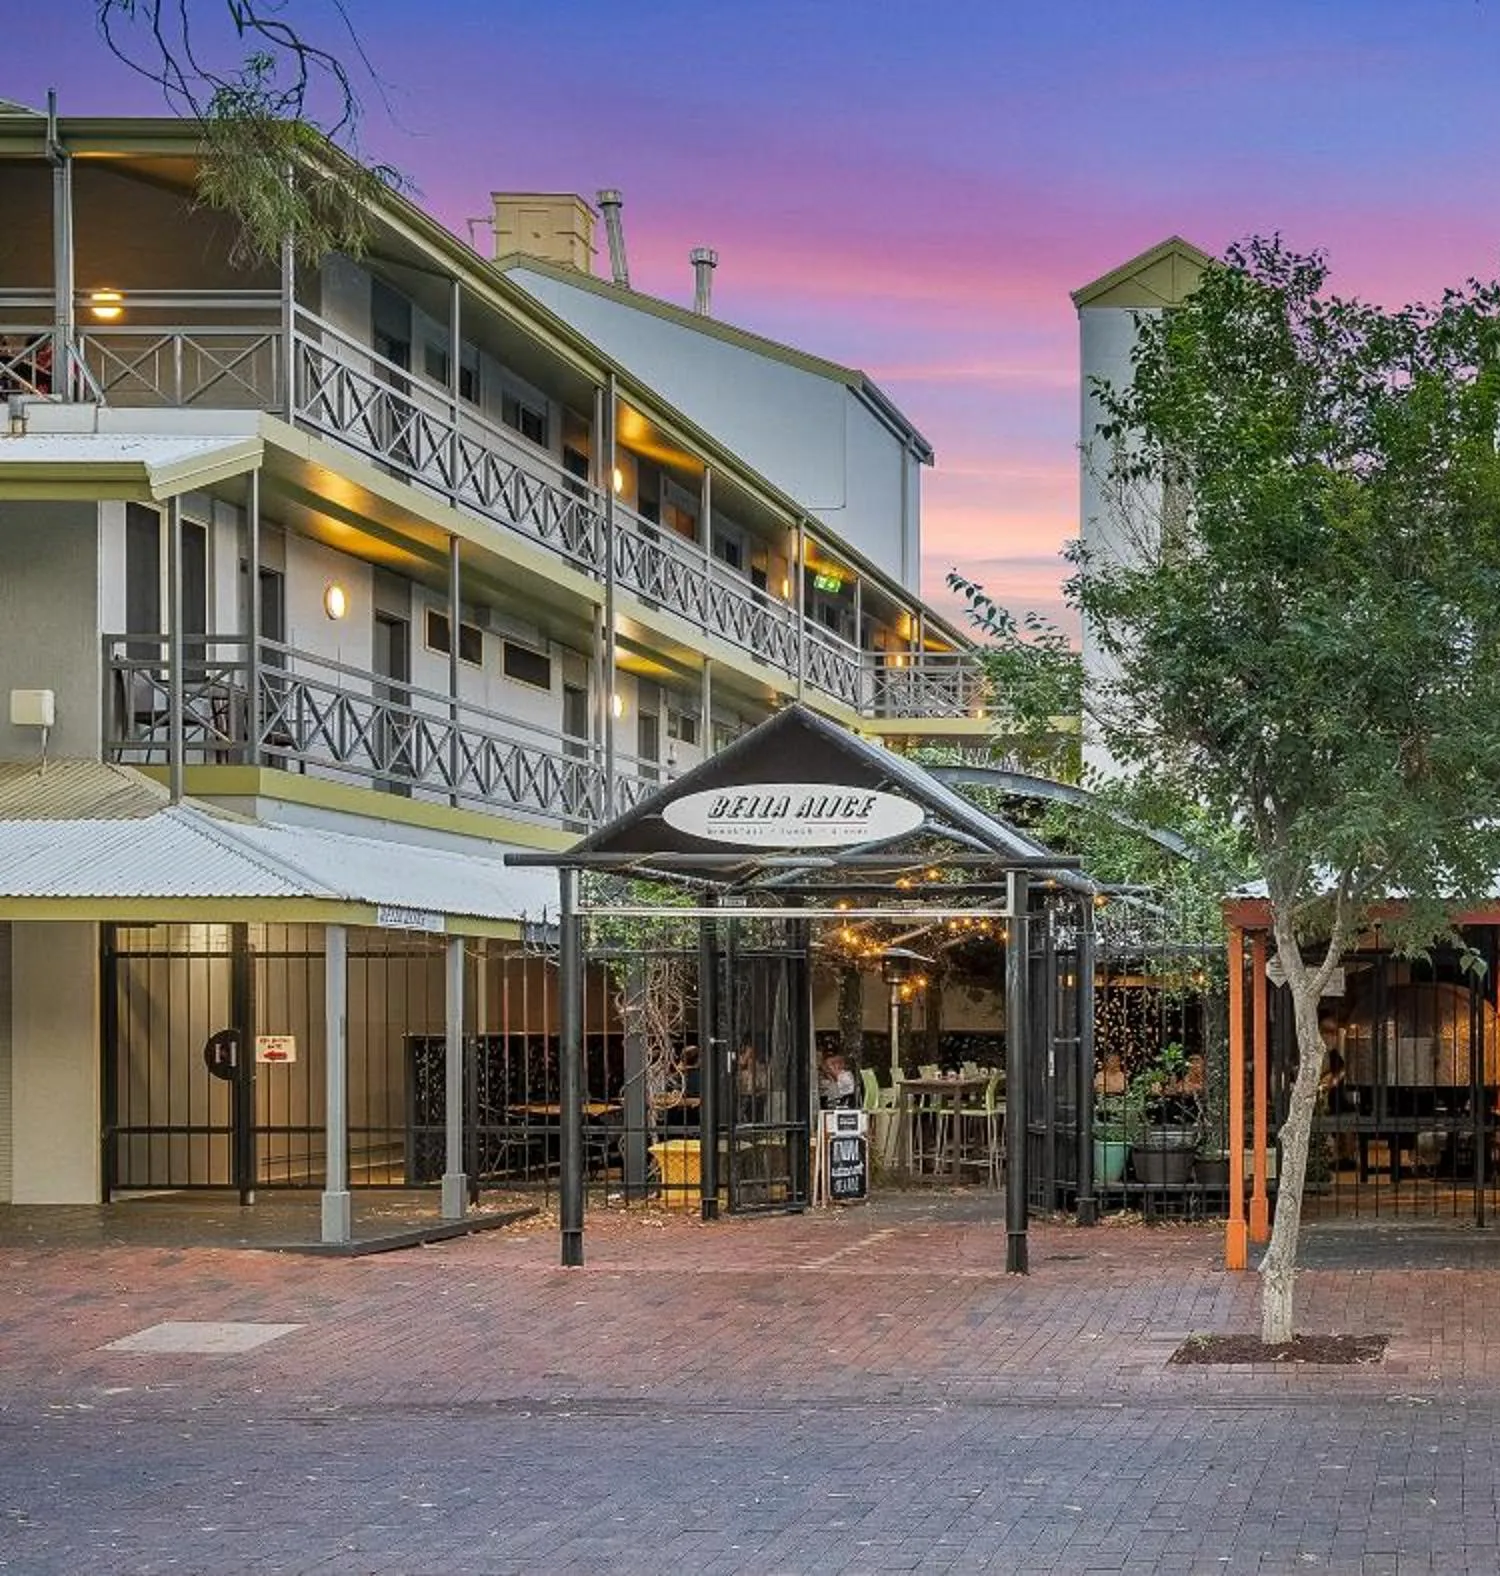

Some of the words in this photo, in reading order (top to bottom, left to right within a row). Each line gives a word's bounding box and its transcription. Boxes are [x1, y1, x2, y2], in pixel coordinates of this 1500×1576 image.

[707, 795, 790, 818] BELLA
[796, 795, 877, 818] ALICE
[707, 827, 764, 836] breakfast
[781, 827, 813, 836] lunch
[831, 827, 869, 836] dinner
